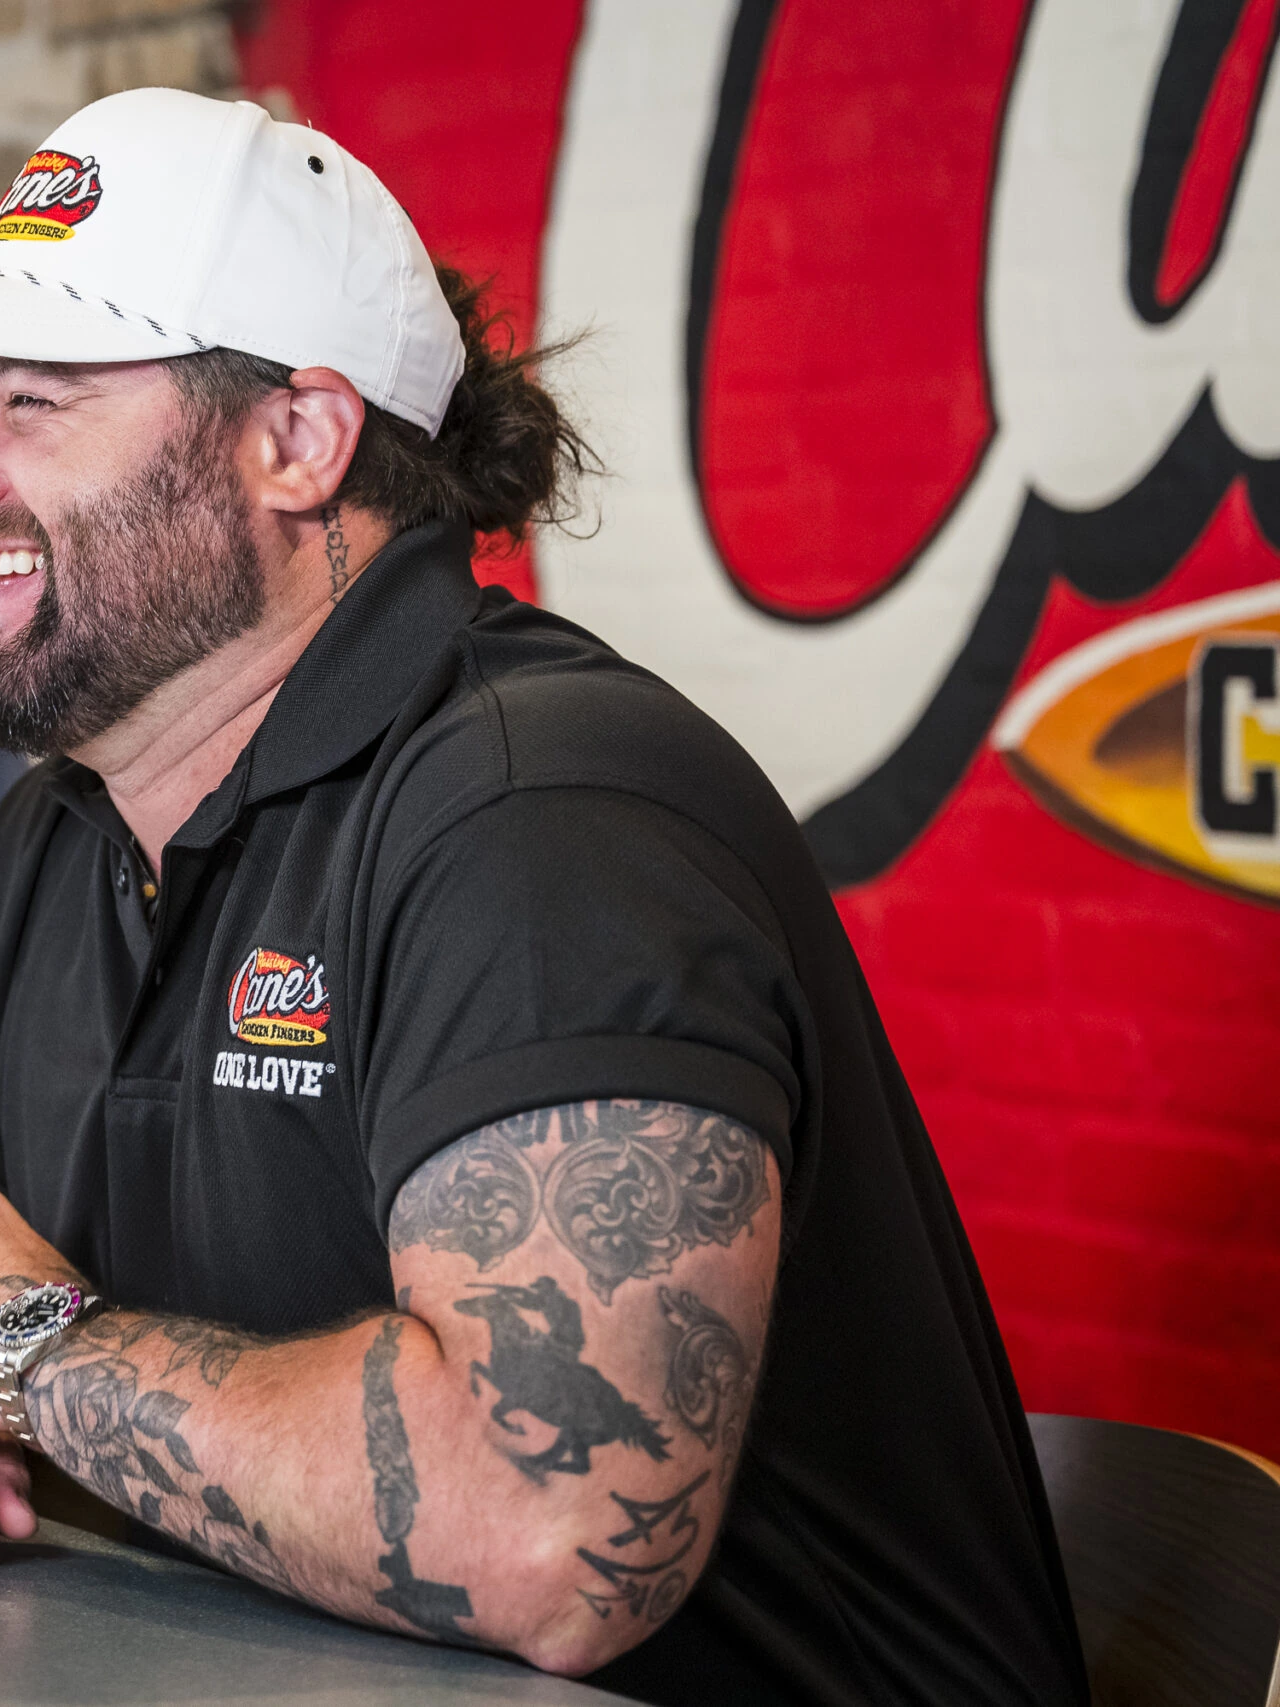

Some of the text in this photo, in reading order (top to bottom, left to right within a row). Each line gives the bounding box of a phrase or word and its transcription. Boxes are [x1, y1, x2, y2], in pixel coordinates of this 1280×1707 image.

[229, 949, 330, 1035] Cane's
[270, 1024, 316, 1043] FINGERS
[213, 1051, 246, 1088] ONE
